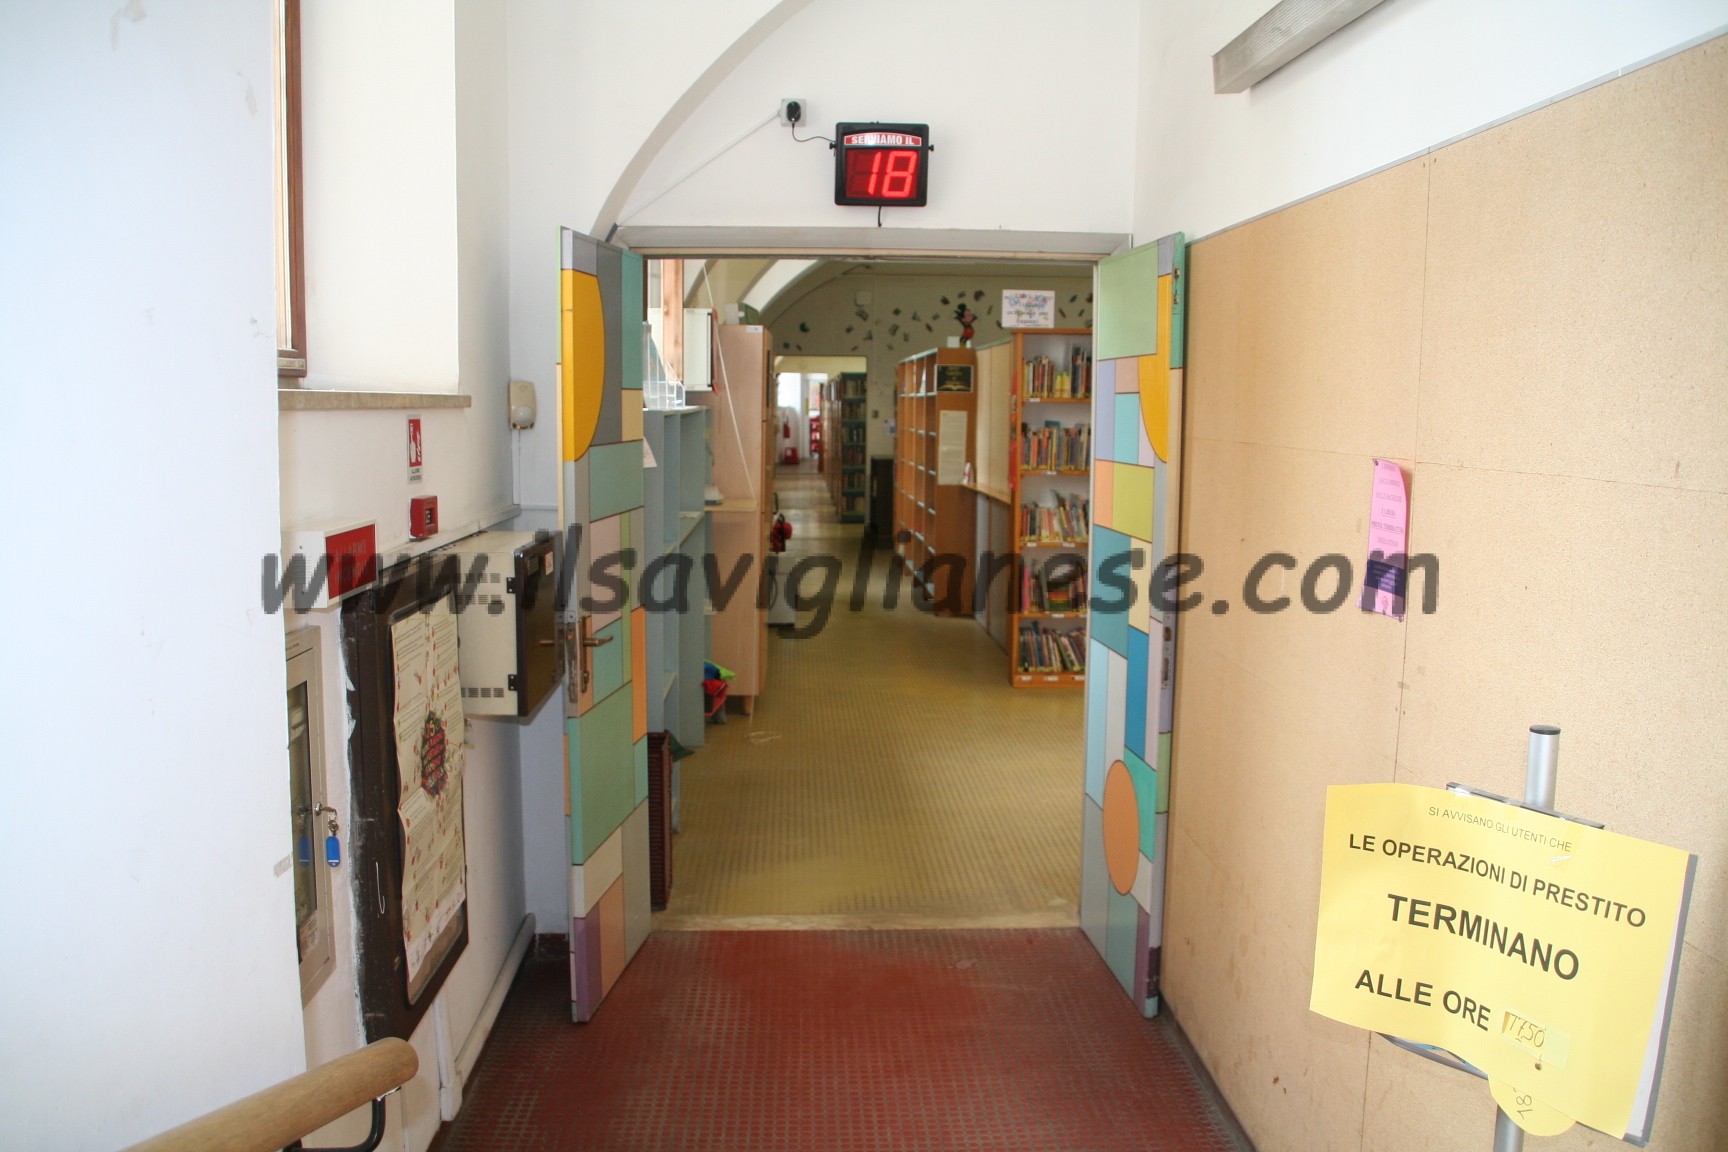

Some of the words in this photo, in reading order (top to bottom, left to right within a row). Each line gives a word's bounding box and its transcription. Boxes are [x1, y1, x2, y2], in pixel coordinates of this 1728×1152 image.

[905, 136, 915, 145] IL
[868, 150, 918, 198] 18
[1428, 806, 1439, 817] SI
[1442, 808, 1494, 829] AVVISANO
[1495, 821, 1510, 834] GLI
[1511, 828, 1548, 845] UTENTI
[1549, 837, 1573, 852] CHE
[1349, 833, 1376, 852] LE
[1382, 838, 1506, 884] OPERAZIONI
[1509, 870, 1528, 892] DI
[1532, 878, 1647, 928] PRESTITO
[1387, 893, 1580, 980] TERMINANO
[1354, 969, 1433, 1007] ALLE
[1442, 989, 1491, 1032] ORE
